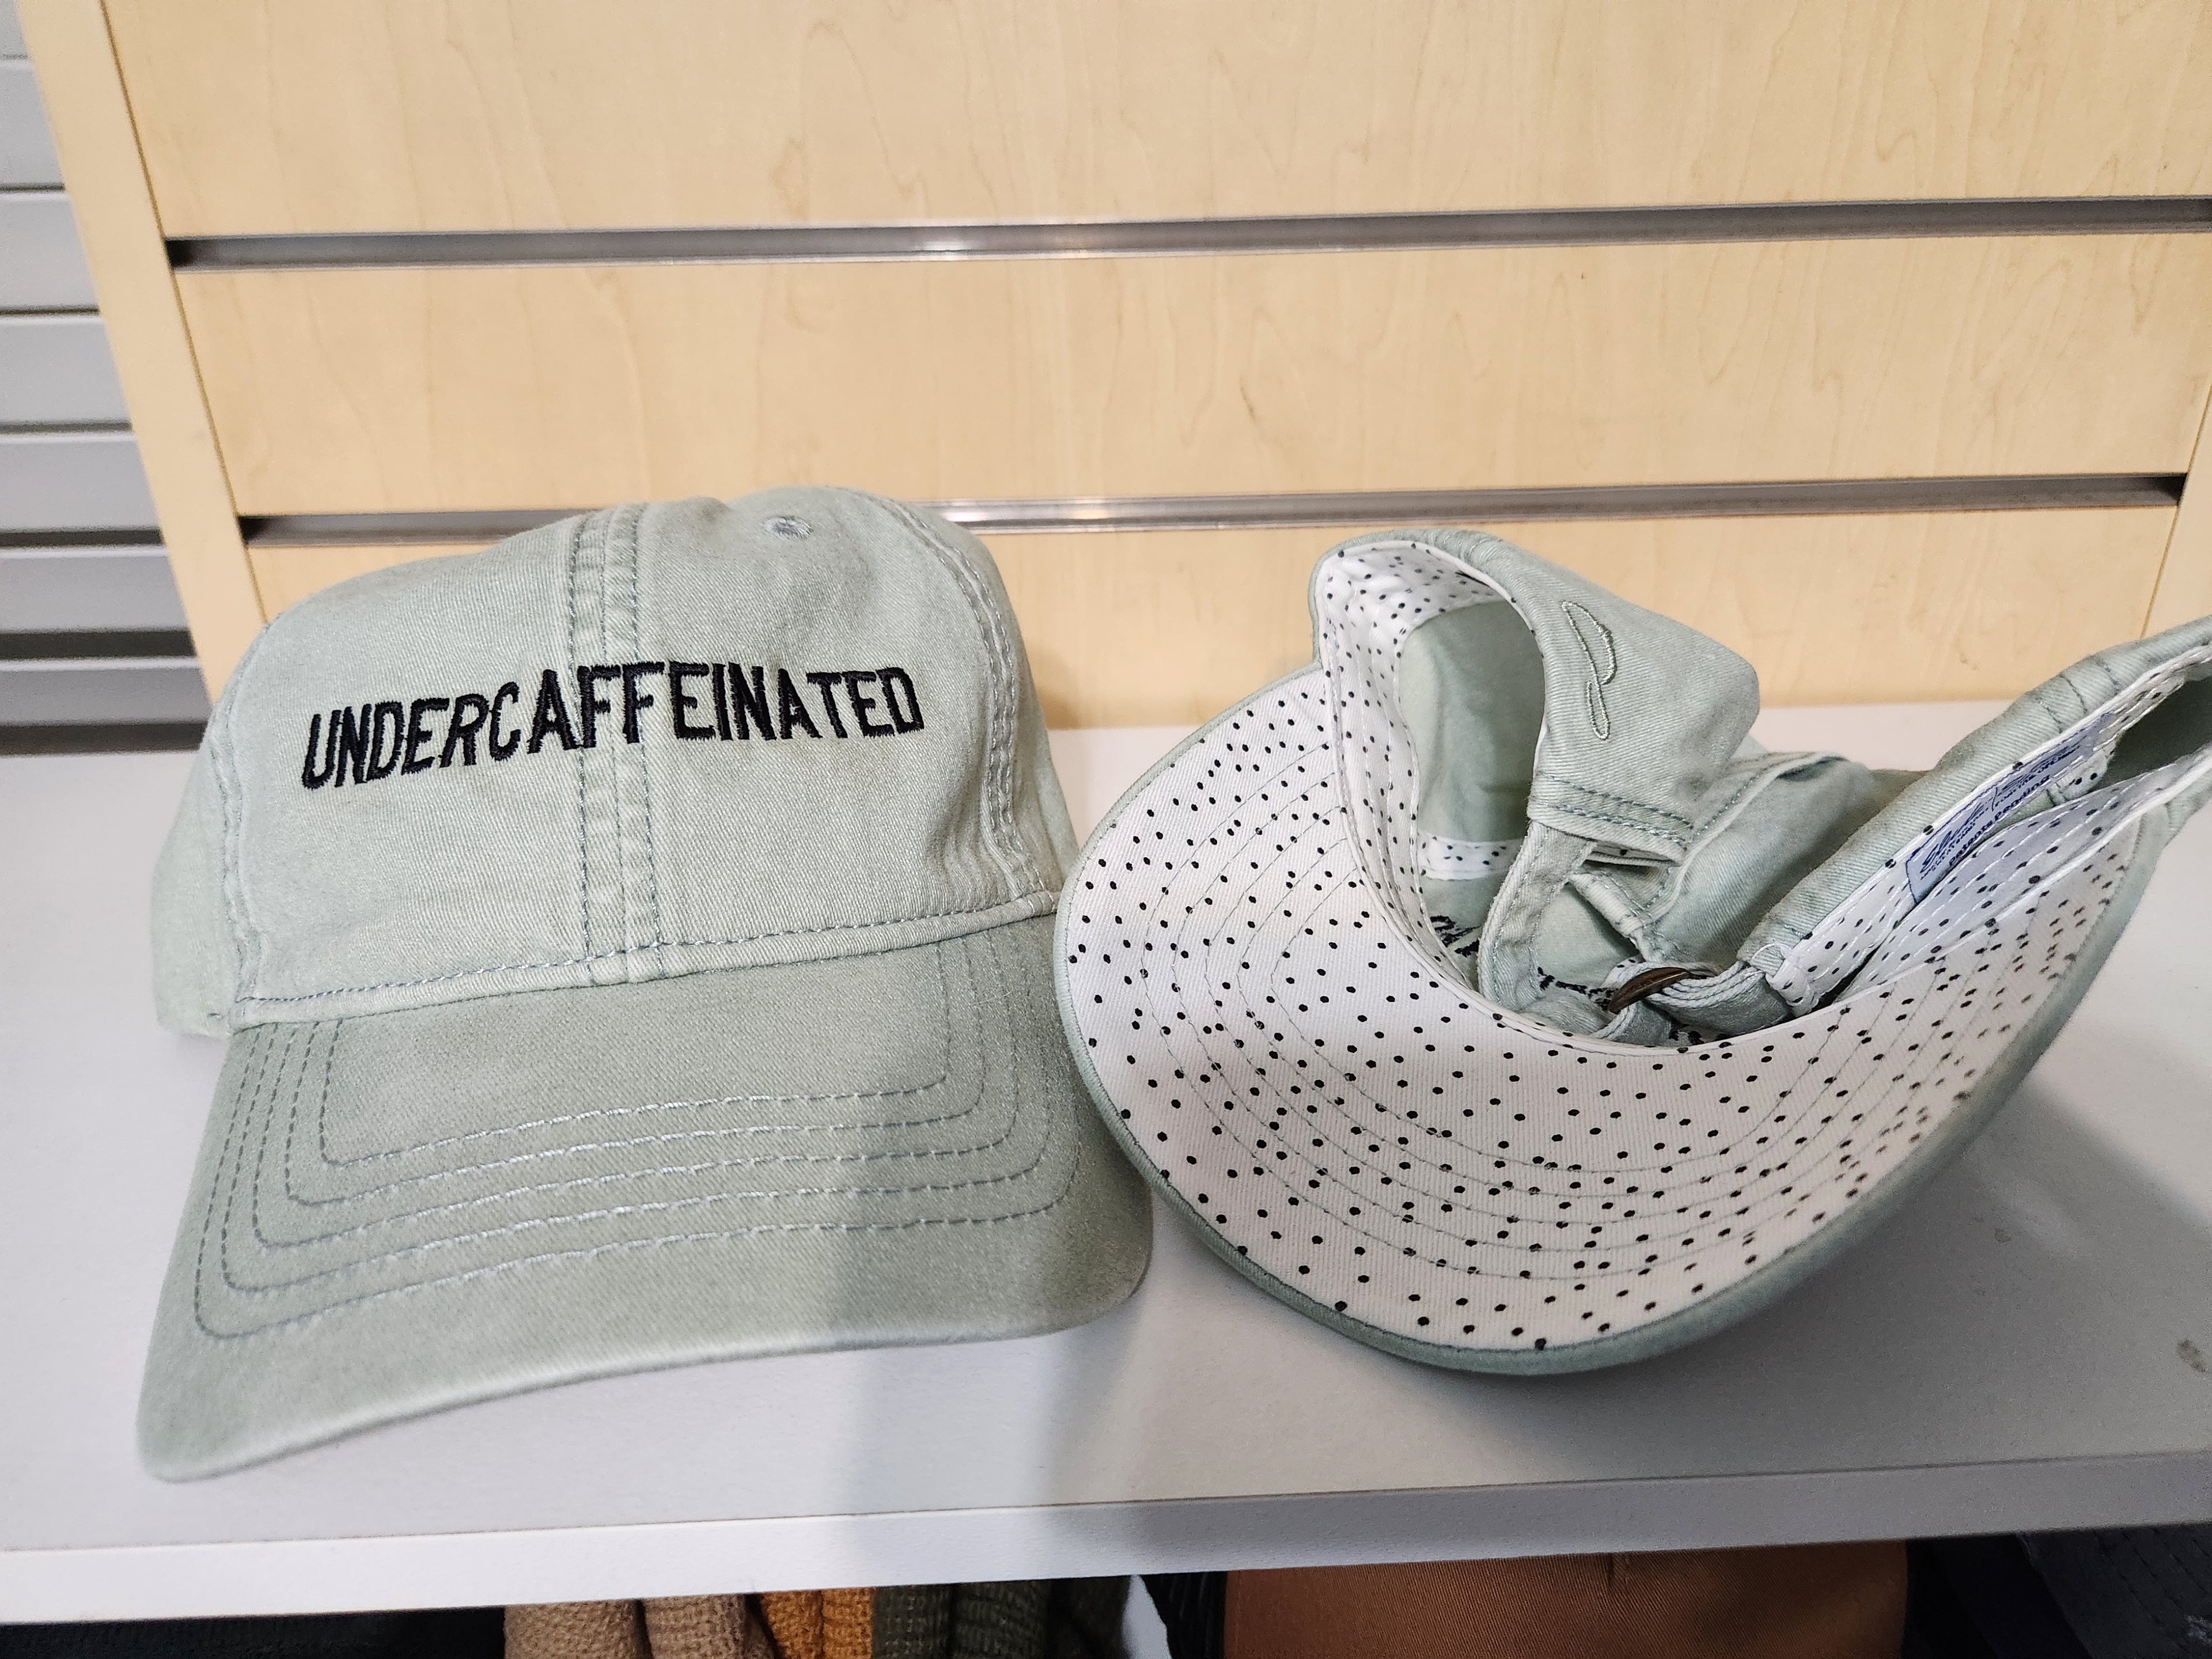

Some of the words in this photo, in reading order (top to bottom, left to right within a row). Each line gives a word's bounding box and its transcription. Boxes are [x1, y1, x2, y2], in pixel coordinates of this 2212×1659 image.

[301, 661, 925, 790] UNDERCAFFEINATED
[1949, 820, 1993, 866] Patents
[1994, 774, 2050, 821] Pending
